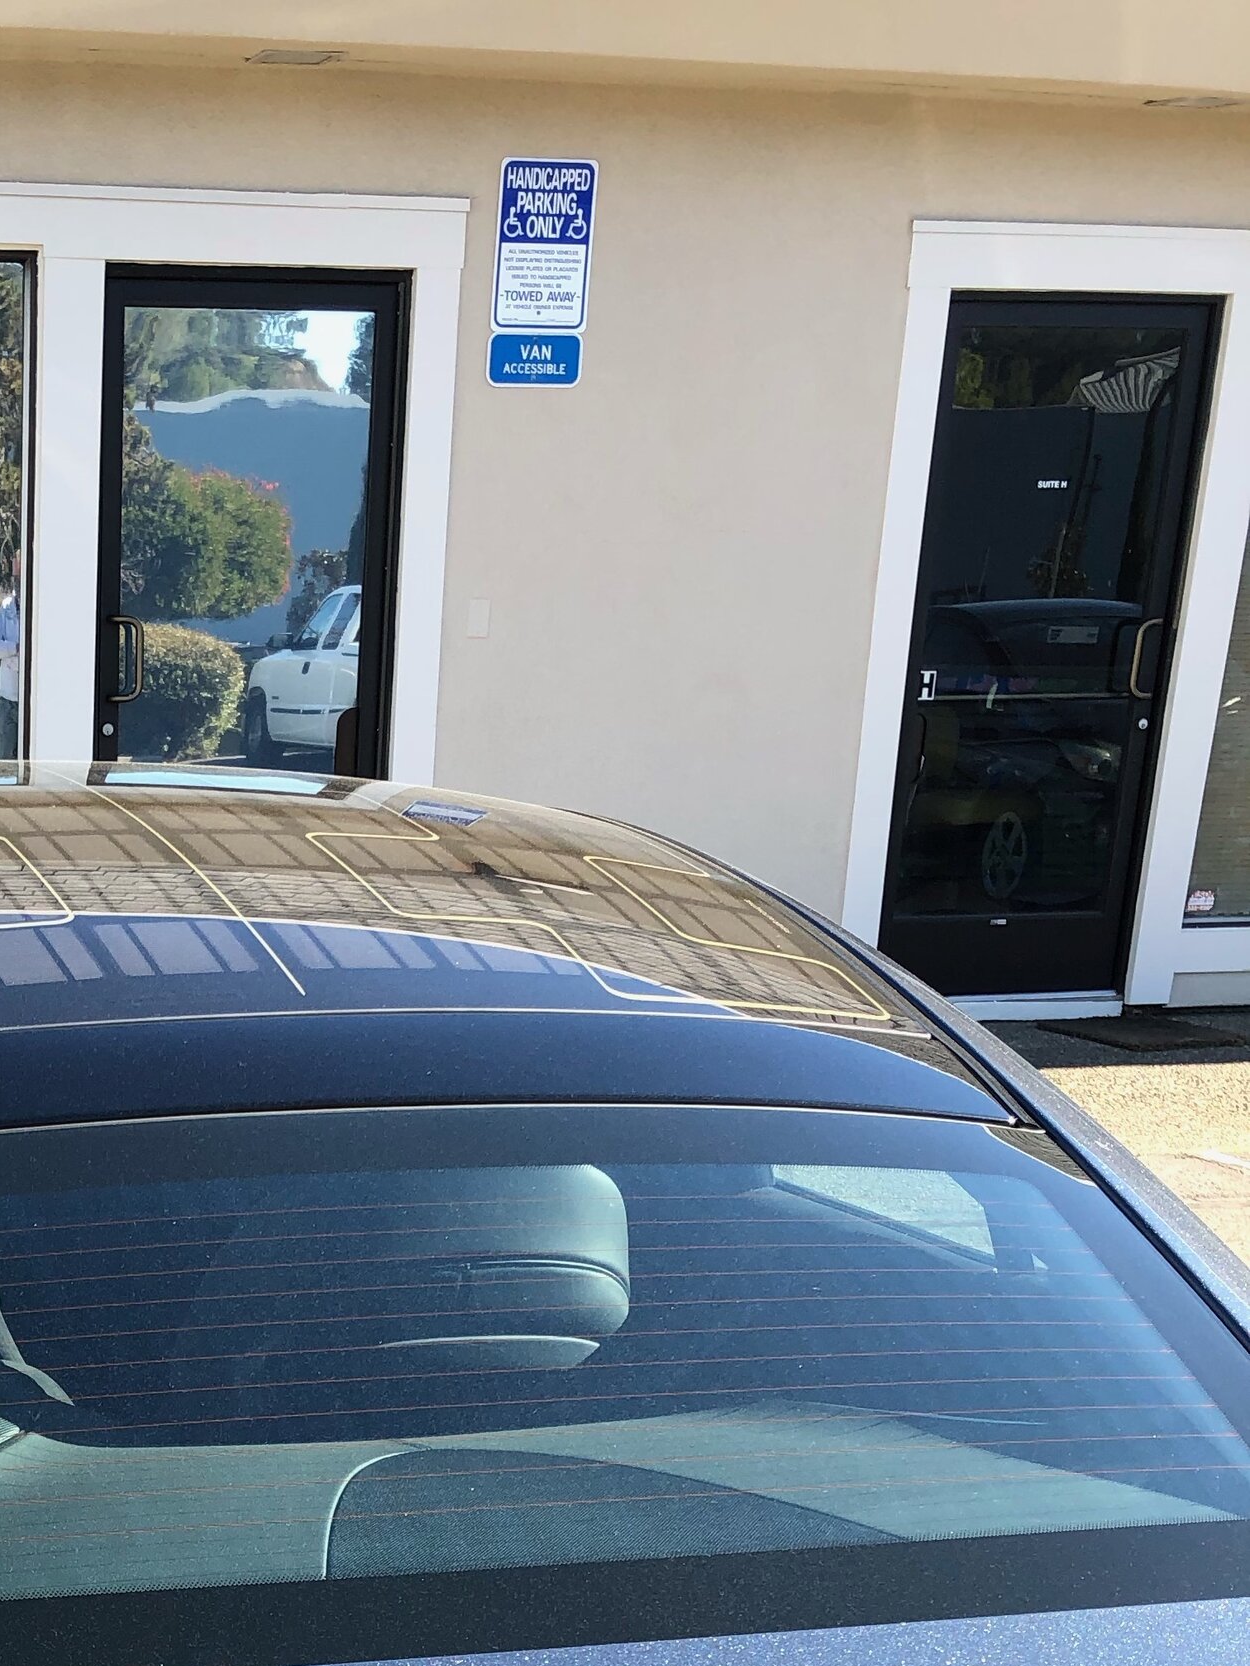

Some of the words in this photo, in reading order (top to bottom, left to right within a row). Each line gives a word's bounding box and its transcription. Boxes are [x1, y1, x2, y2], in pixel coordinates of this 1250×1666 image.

[506, 166, 591, 192] HANDICAPPED
[516, 191, 578, 215] PARKING
[526, 215, 565, 239] ONLY
[520, 344, 552, 361] VAN
[502, 363, 567, 375] ACCESSIBLE
[1037, 480, 1060, 489] SUITE
[1060, 480, 1067, 489] H
